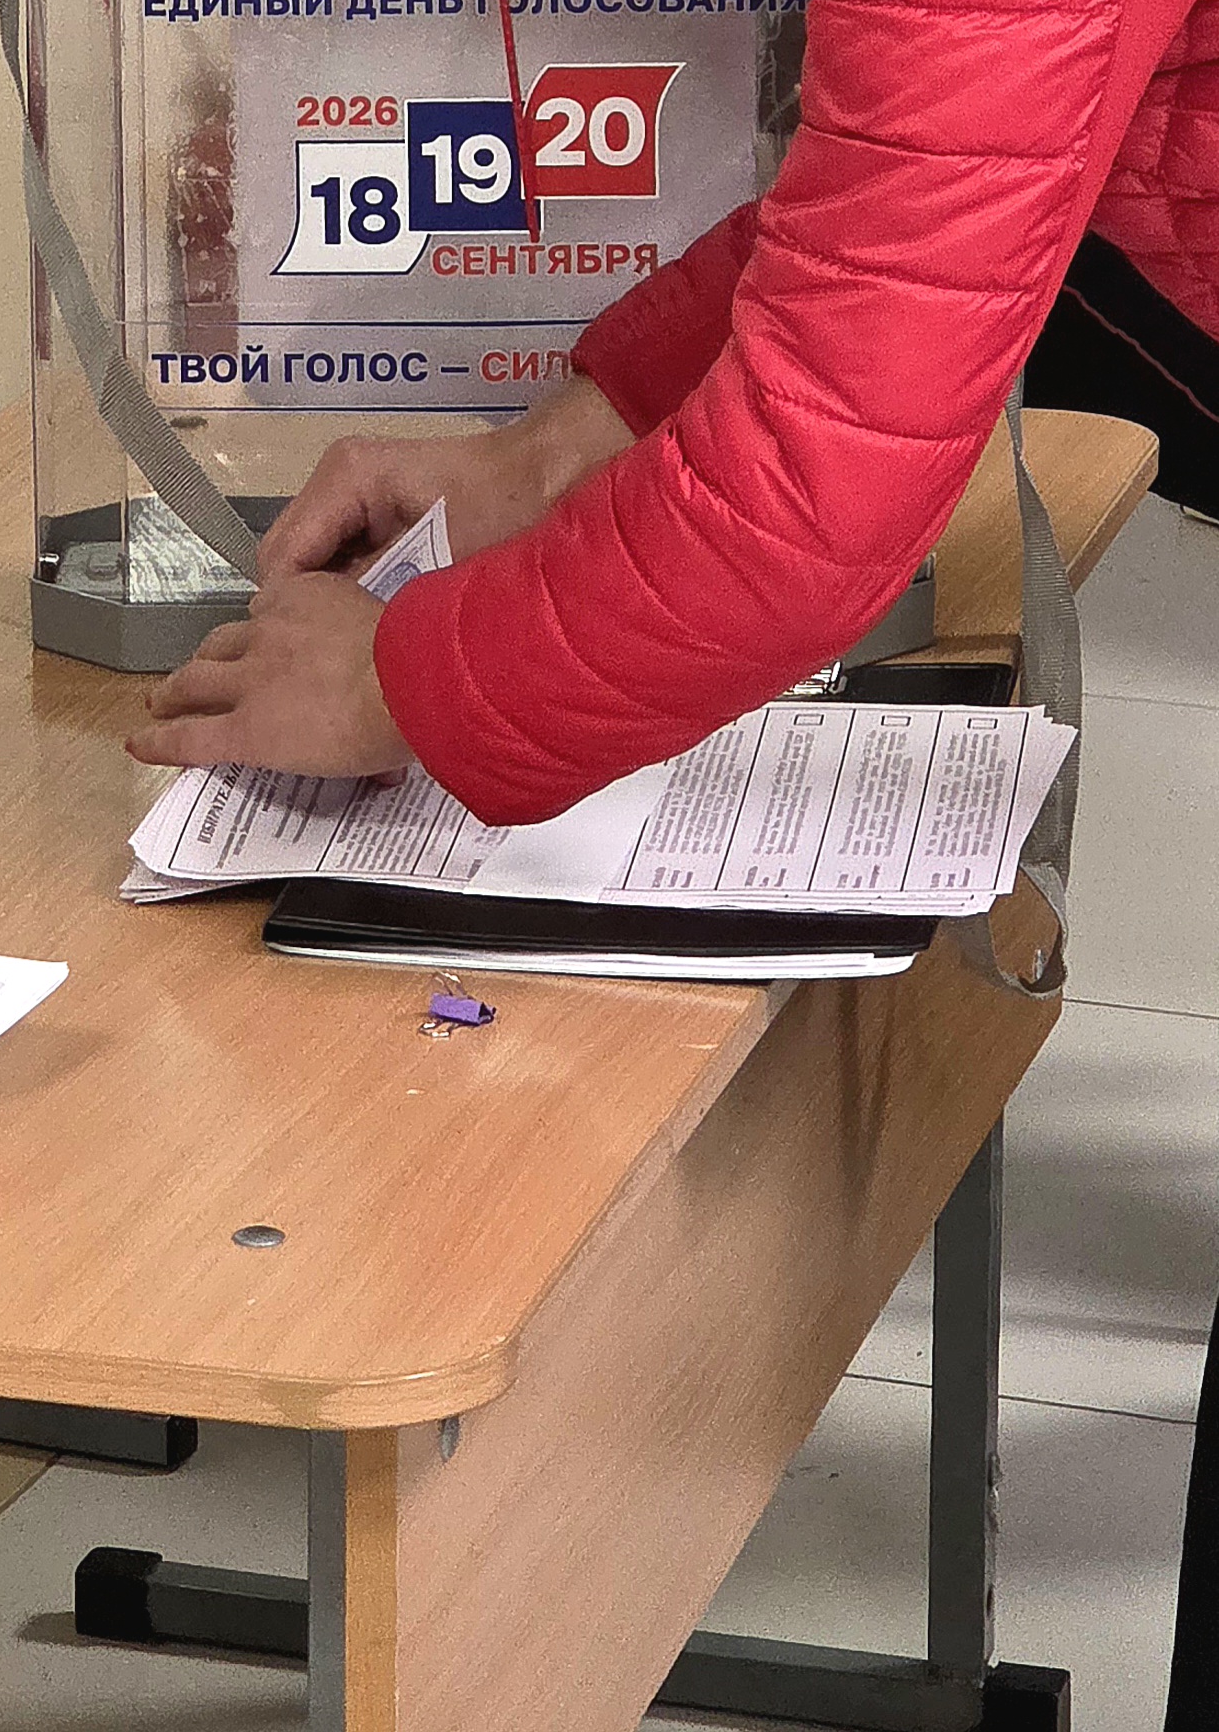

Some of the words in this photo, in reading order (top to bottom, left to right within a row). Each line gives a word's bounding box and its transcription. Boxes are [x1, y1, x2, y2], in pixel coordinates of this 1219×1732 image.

[296, 96, 398, 127] 2026
[533, 97, 647, 167] 20
[421, 133, 512, 205] 19
[310, 176, 401, 246] 18
[431, 243, 659, 277] СЕНТЯБРЯ
[152, 343, 270, 384] ТВОЙ
[283, 351, 429, 384] ГОЛОС
[481, 351, 569, 384] СИЛ
